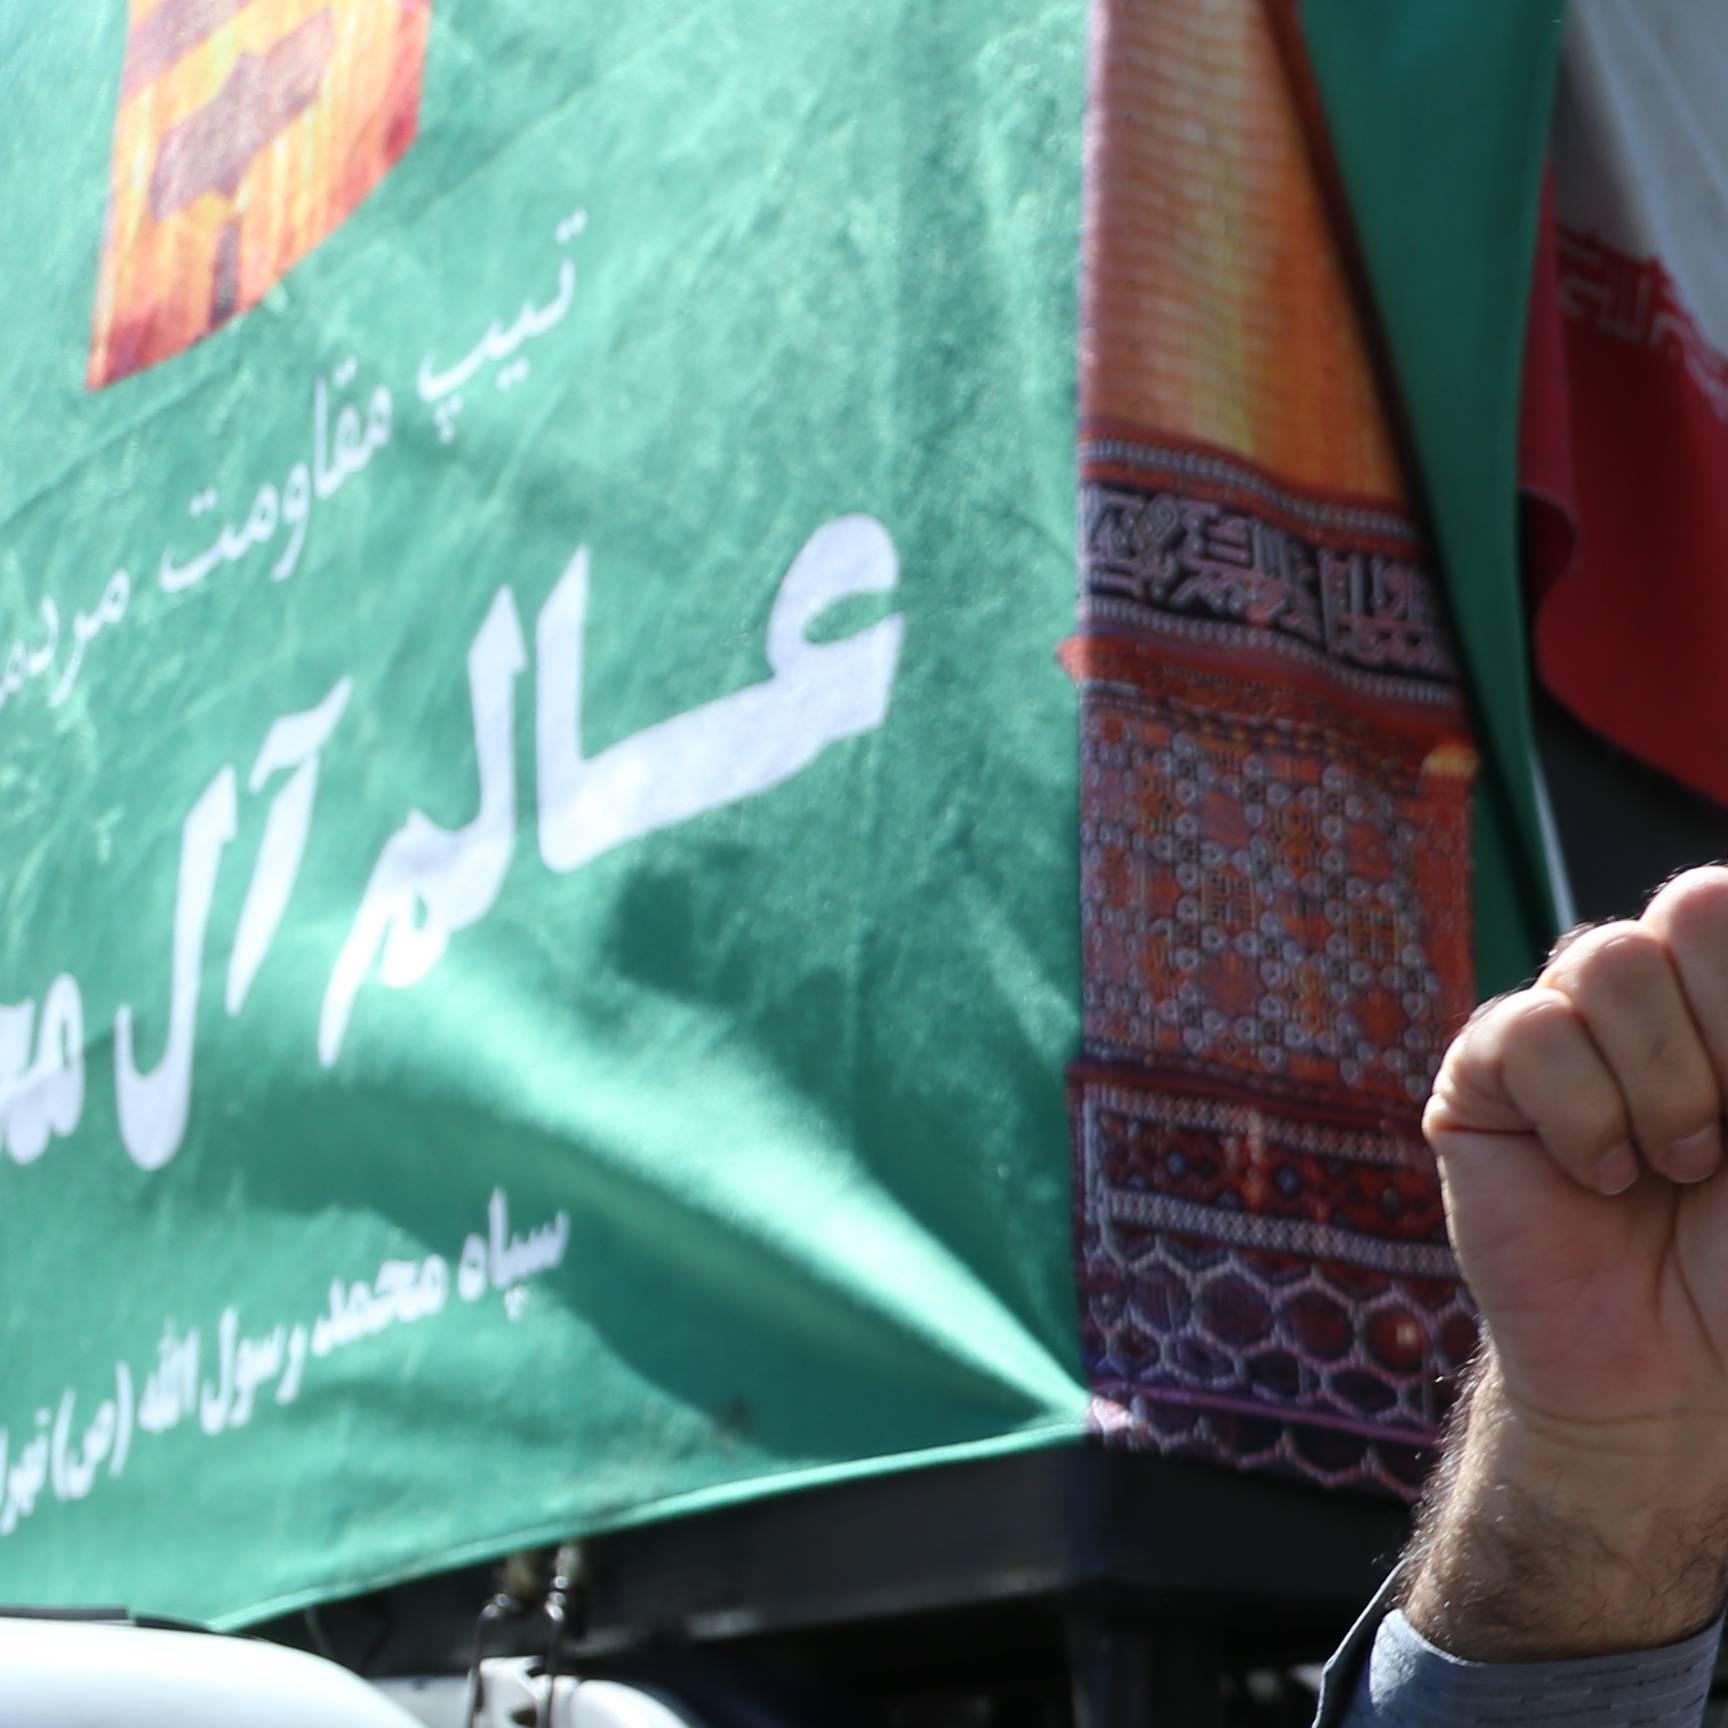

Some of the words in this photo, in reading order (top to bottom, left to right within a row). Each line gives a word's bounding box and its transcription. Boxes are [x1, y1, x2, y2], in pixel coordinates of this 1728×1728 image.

[416, 209, 588, 445] تیپ
[158, 356, 394, 595] مقاومت
[0, 566, 131, 709] مردم
[318, 514, 902, 1068] عالم
[116, 676, 354, 1169] آل
[311, 1253, 448, 1357] محمد
[457, 1186, 569, 1322] سپاه
[137, 1317, 201, 1435] الله
[199, 1306, 308, 1436] رسول
